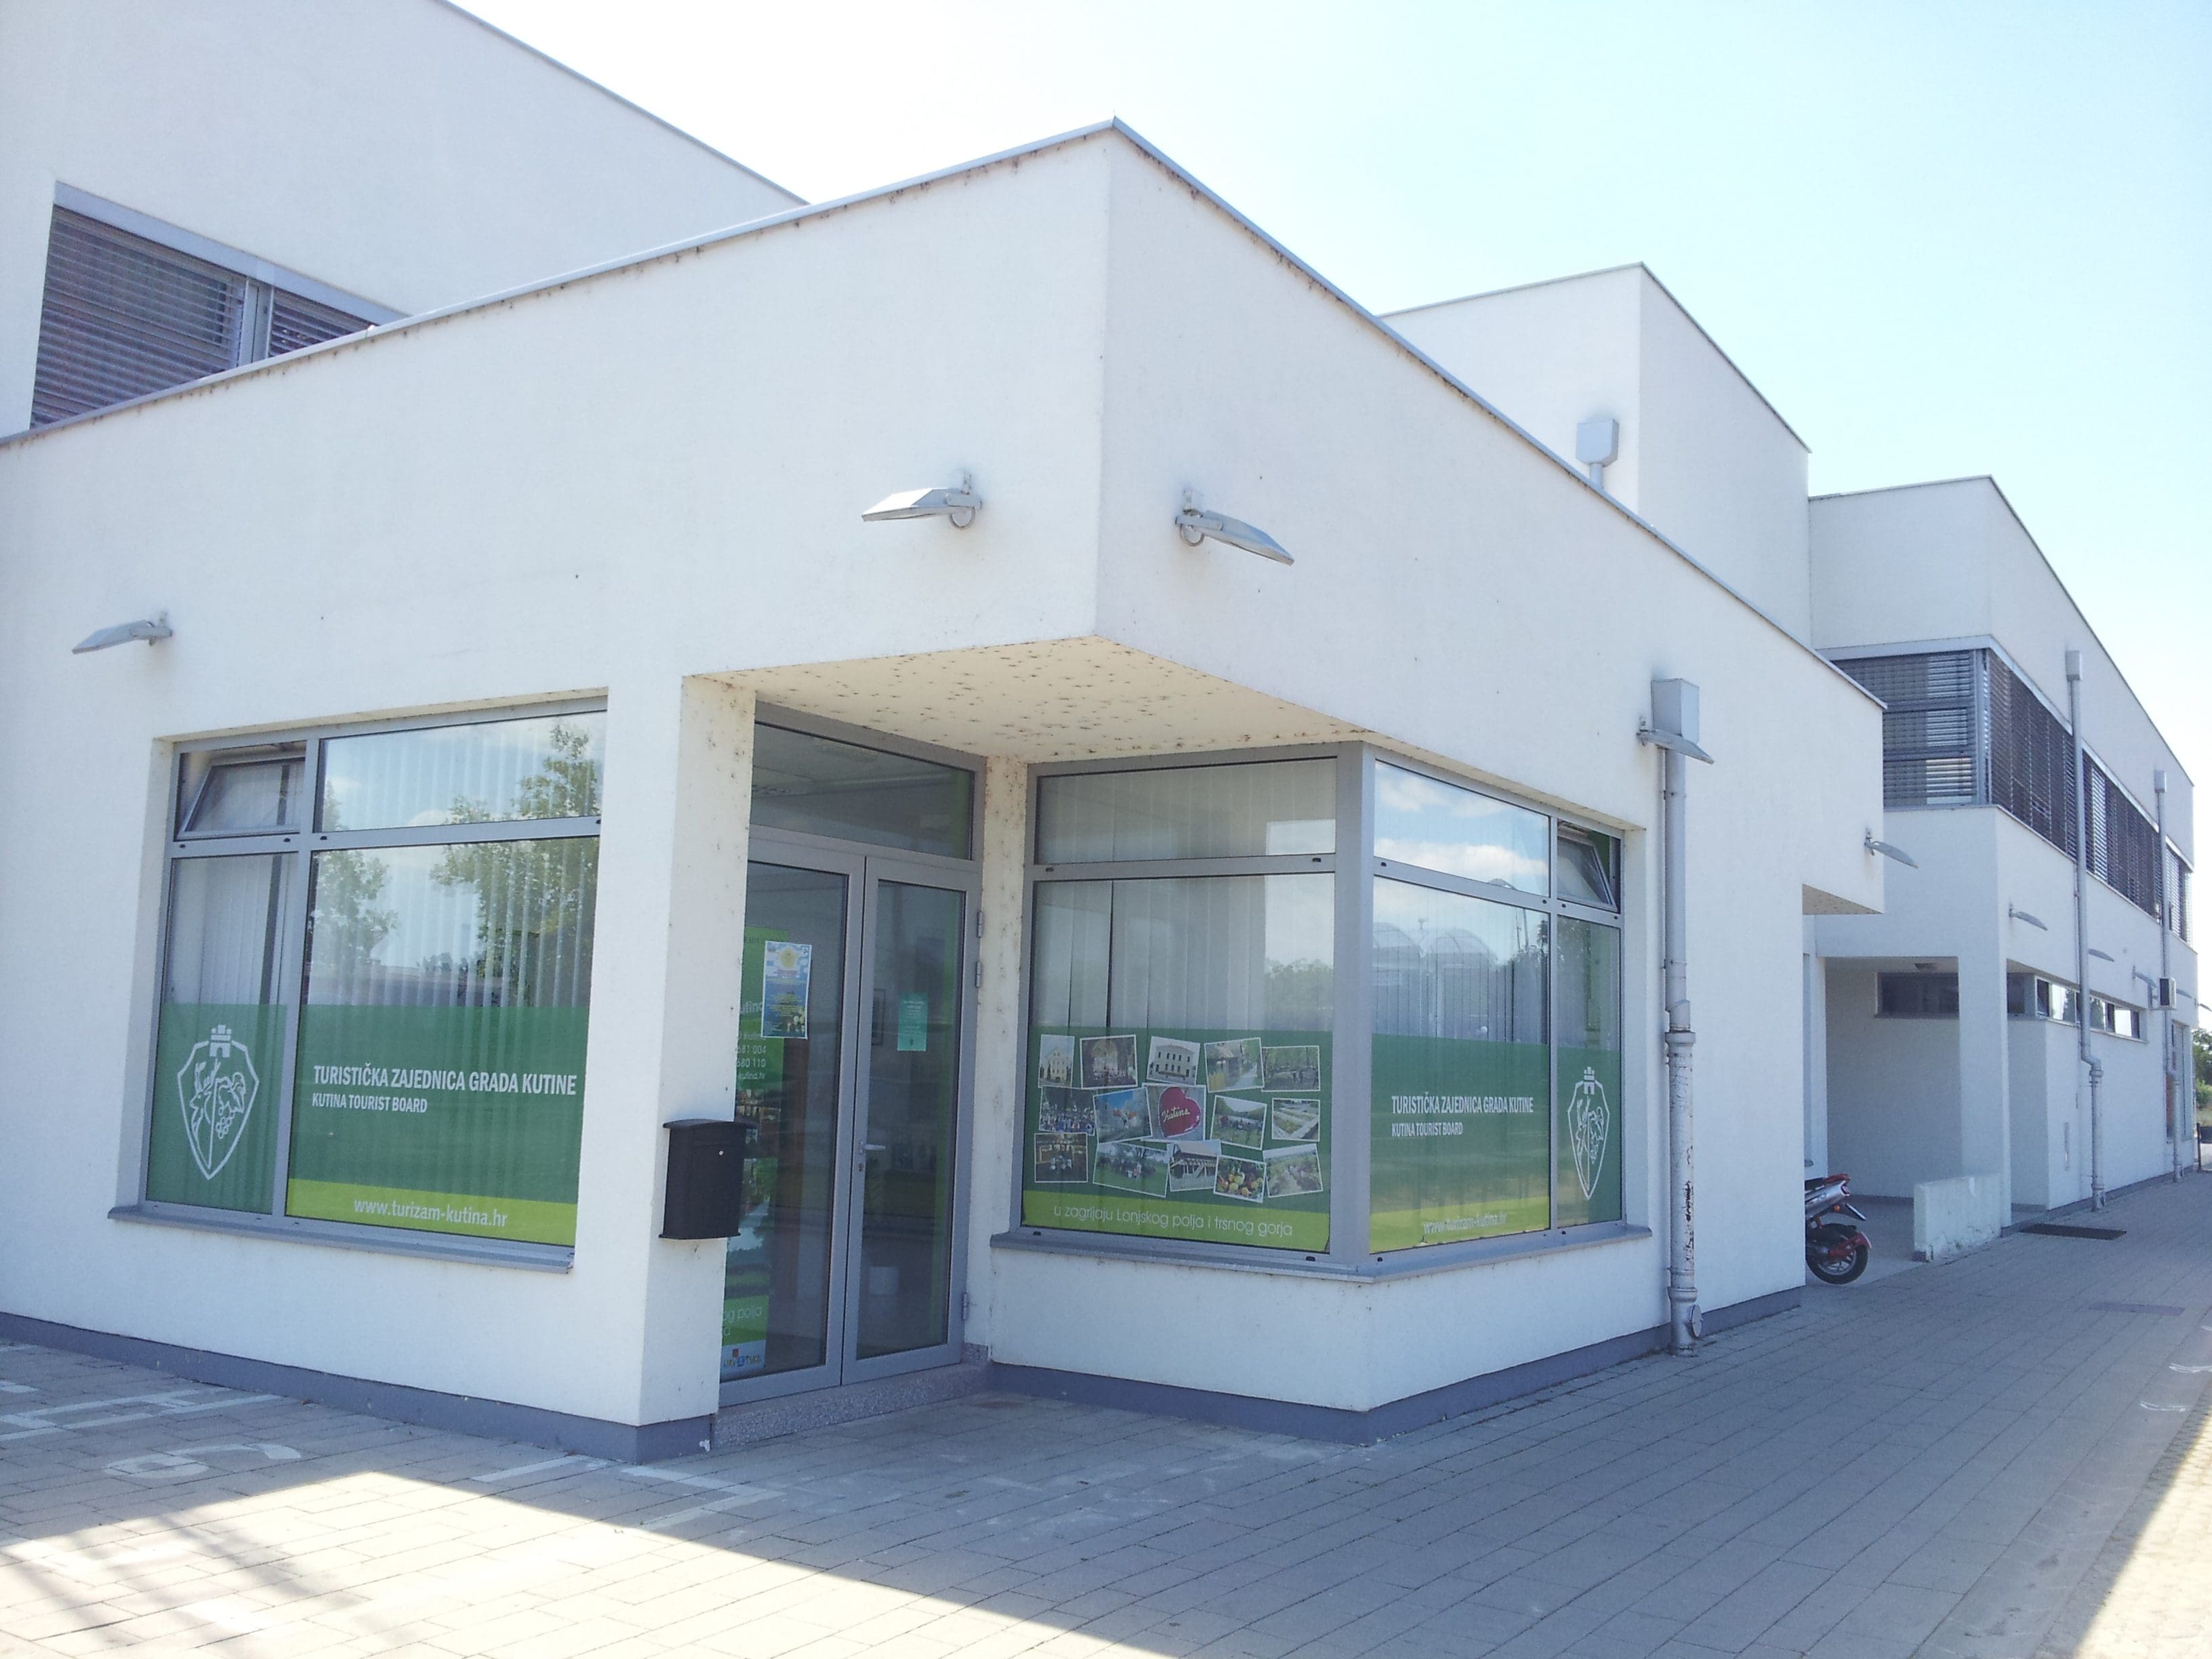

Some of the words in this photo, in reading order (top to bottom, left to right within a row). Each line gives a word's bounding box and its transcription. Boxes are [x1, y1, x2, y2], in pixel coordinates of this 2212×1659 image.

[753, 1059, 766, 1068] 110
[314, 1063, 388, 1087] TURISTIČKA
[390, 1069, 466, 1091] ZAJEDNICA
[469, 1072, 518, 1093] GRADA
[522, 1073, 577, 1096] KUTINE
[312, 1092, 347, 1109] KUTINA
[348, 1094, 390, 1111] TOURIST
[392, 1097, 428, 1113] BOARD
[1391, 1091, 1440, 1114] TURISTIČKA
[1441, 1096, 1482, 1113] ZAJEDNICA
[1483, 1097, 1509, 1113] GRADA
[1509, 1097, 1534, 1113] KUTINE
[1391, 1123, 1415, 1137] KUTINA
[1415, 1122, 1442, 1136] TOURIST
[1442, 1122, 1464, 1135] BOARD
[354, 1199, 508, 1227] www.turizam-kutina.hr
[1054, 1206, 1061, 1216] u
[1117, 1209, 1168, 1228] Lonjskog
[1172, 1214, 1204, 1230] polja
[1214, 1216, 1254, 1235] trsnog
[1258, 1222, 1293, 1237] gorja
